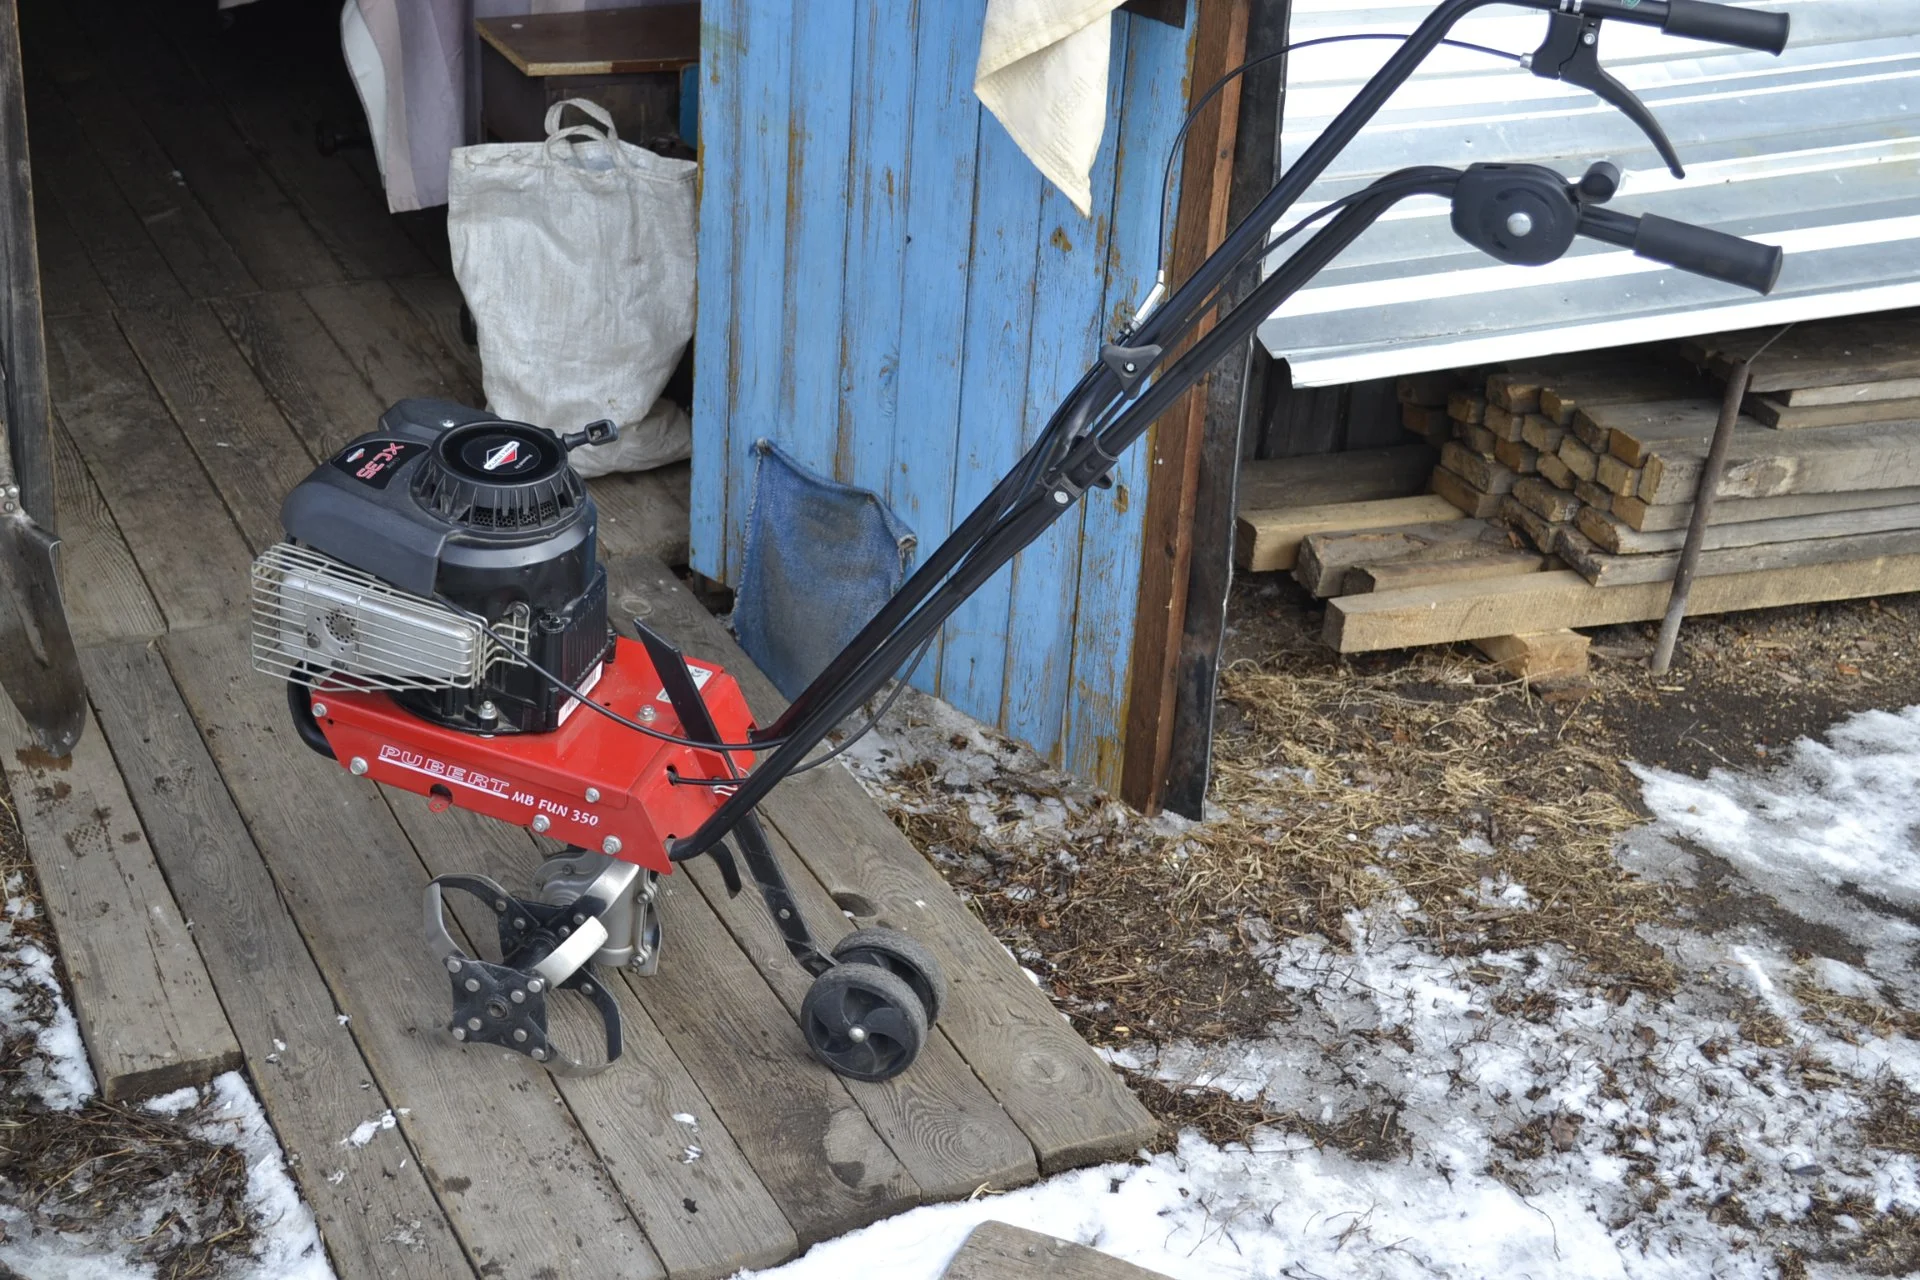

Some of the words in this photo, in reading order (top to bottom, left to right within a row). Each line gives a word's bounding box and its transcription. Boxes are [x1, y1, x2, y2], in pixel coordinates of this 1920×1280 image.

[356, 442, 404, 479] XC35
[379, 744, 510, 793] PUBERT
[511, 791, 534, 806] MB
[538, 799, 568, 817] FUN
[571, 809, 599, 826] 350
